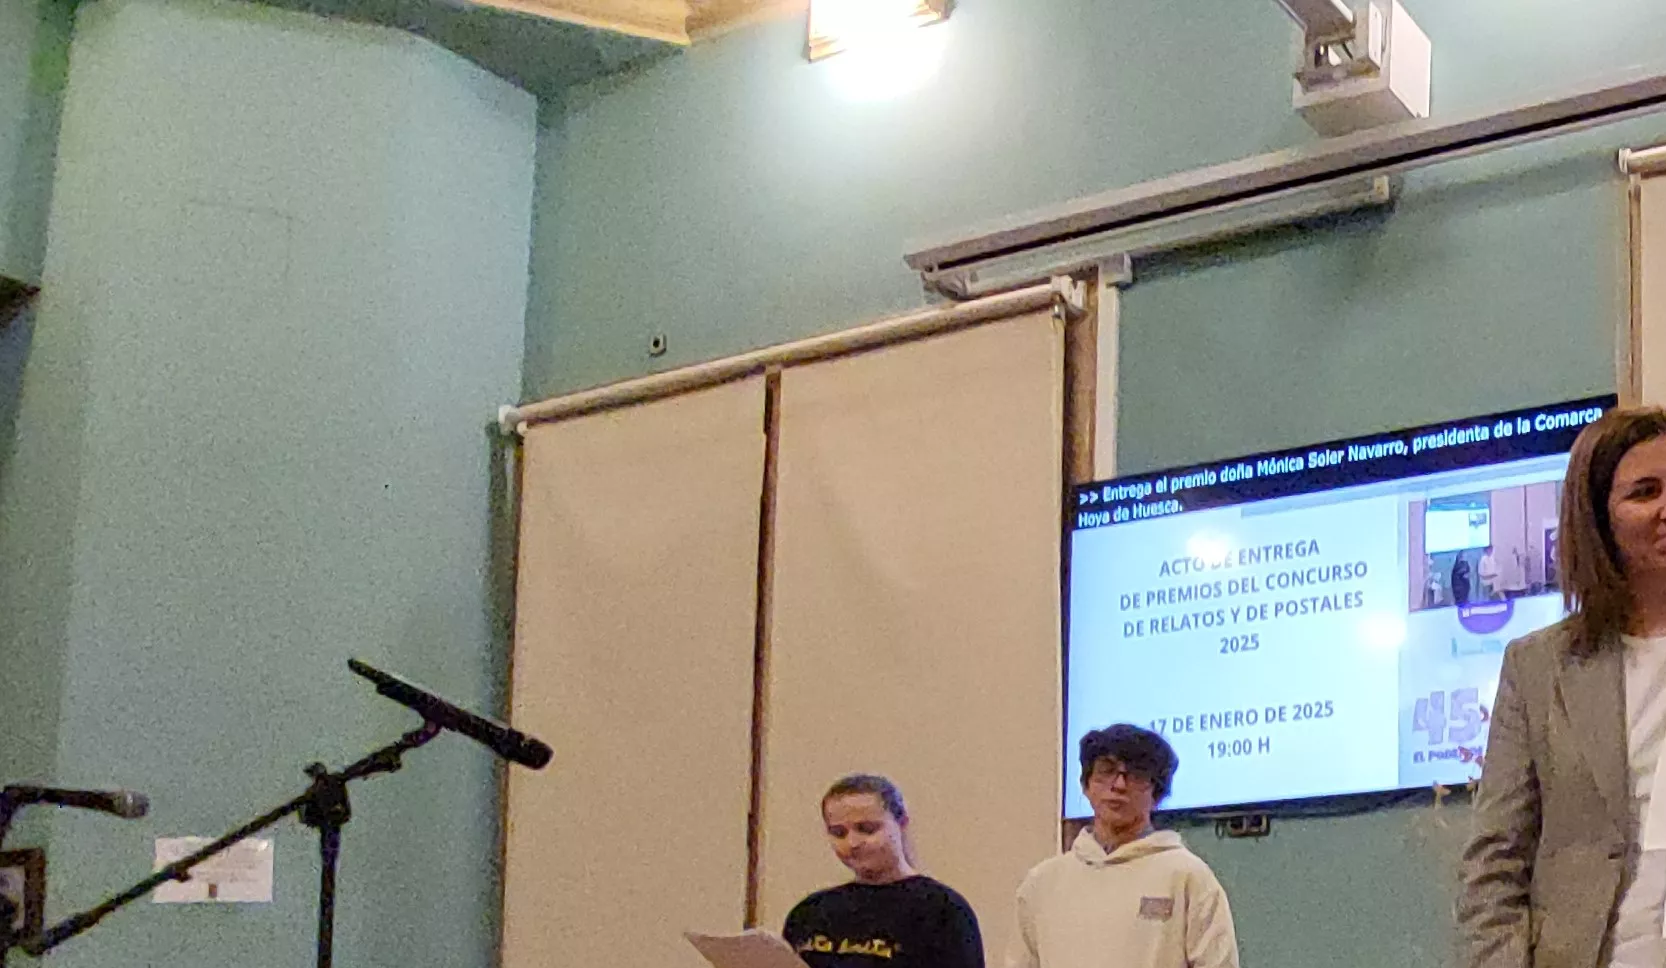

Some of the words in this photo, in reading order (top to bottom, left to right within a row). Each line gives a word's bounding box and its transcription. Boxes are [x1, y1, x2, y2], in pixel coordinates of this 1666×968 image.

[1102, 481, 1152, 503] Entrega
[1155, 479, 1167, 494] el
[1171, 469, 1217, 493] premio
[1220, 464, 1253, 482] doña
[1257, 455, 1304, 477] Mónica
[1308, 448, 1344, 469] Soler
[1348, 438, 1409, 463] Navarro,
[1413, 424, 1489, 454] presidenta
[1494, 420, 1512, 438] de
[1517, 416, 1530, 434] la
[1535, 407, 1602, 431] Comarca
[1078, 508, 1110, 529] Hoya
[1113, 506, 1129, 523] de
[1133, 498, 1183, 519] Huesca.
[1238, 538, 1320, 566] ENTREGA
[1120, 592, 1141, 611] DE
[1146, 581, 1222, 607] PREMIOS
[1228, 577, 1260, 596] DEL
[1265, 561, 1368, 591] CONCURSO
[1123, 620, 1144, 639] DE
[1150, 609, 1225, 635] RELATOS
[1230, 606, 1241, 624] Y
[1246, 603, 1268, 622] DE
[1273, 590, 1364, 618] POSTALES
[1219, 633, 1260, 654] 2025
[1150, 717, 1168, 736] 17
[1172, 714, 1194, 733] DE
[1200, 708, 1259, 732] ENERO
[1264, 705, 1287, 724] DE
[1292, 700, 1335, 722] 2025
[1412, 687, 1482, 745] 45
[1207, 738, 1252, 759] 19:00
[1258, 736, 1271, 755] H
